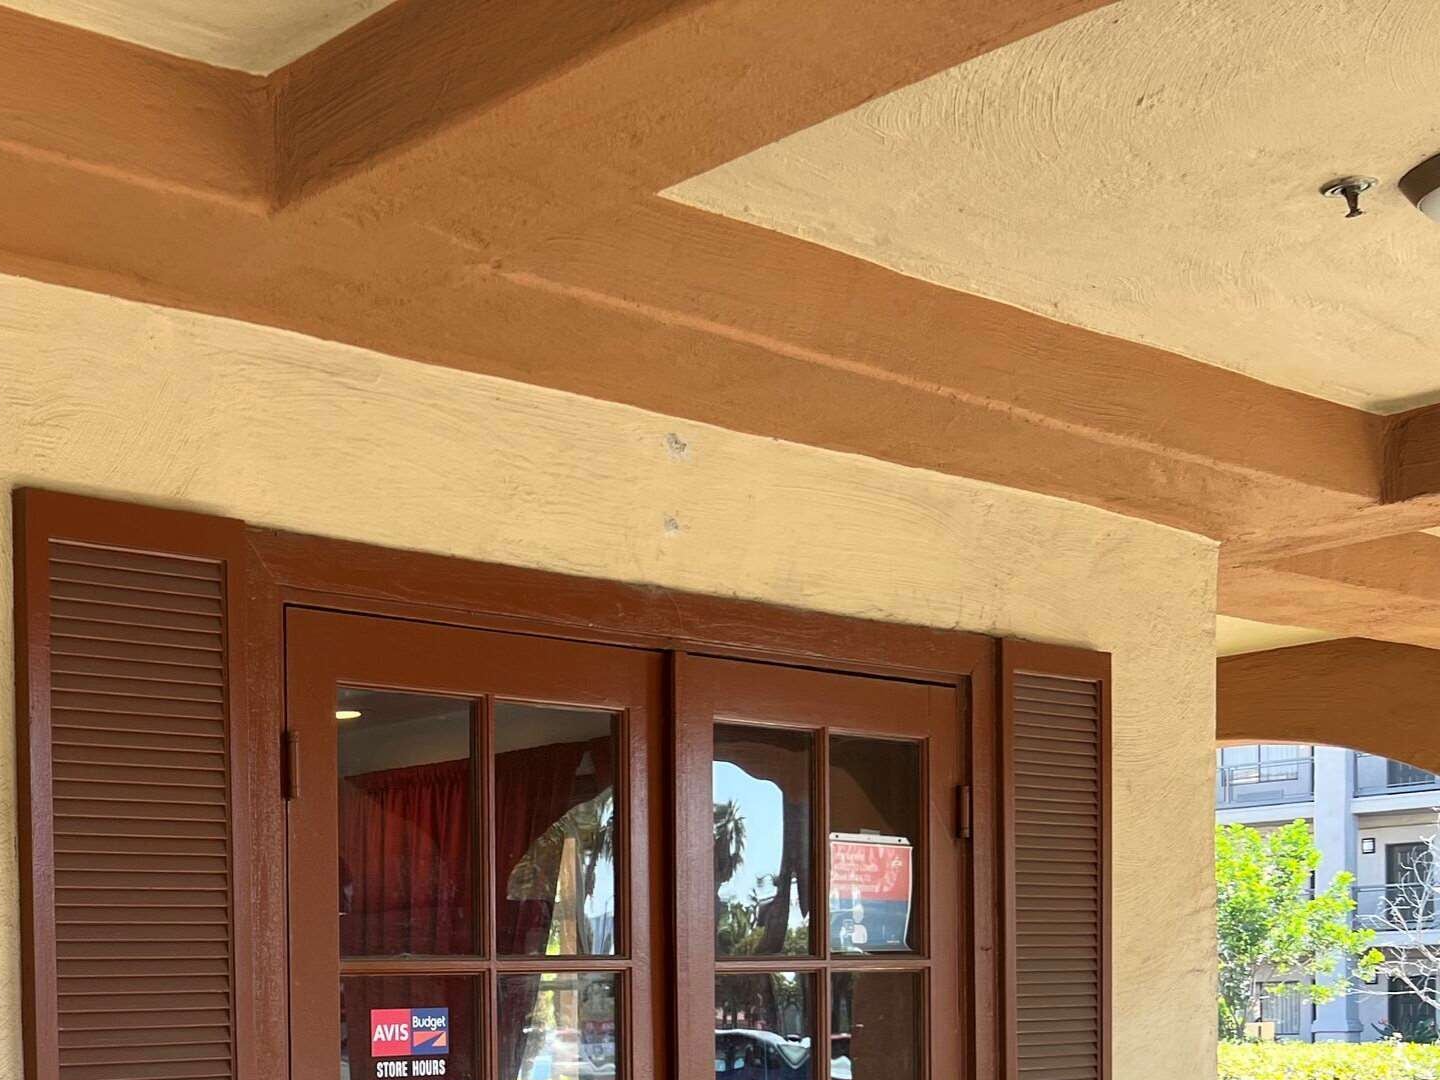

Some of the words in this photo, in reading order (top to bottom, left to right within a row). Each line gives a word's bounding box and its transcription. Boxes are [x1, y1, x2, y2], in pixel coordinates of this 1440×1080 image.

[373, 1023, 409, 1041] AVIS
[412, 1015, 446, 1031] Budget
[376, 1061, 408, 1078] STORE
[412, 1060, 446, 1077] HOURS
